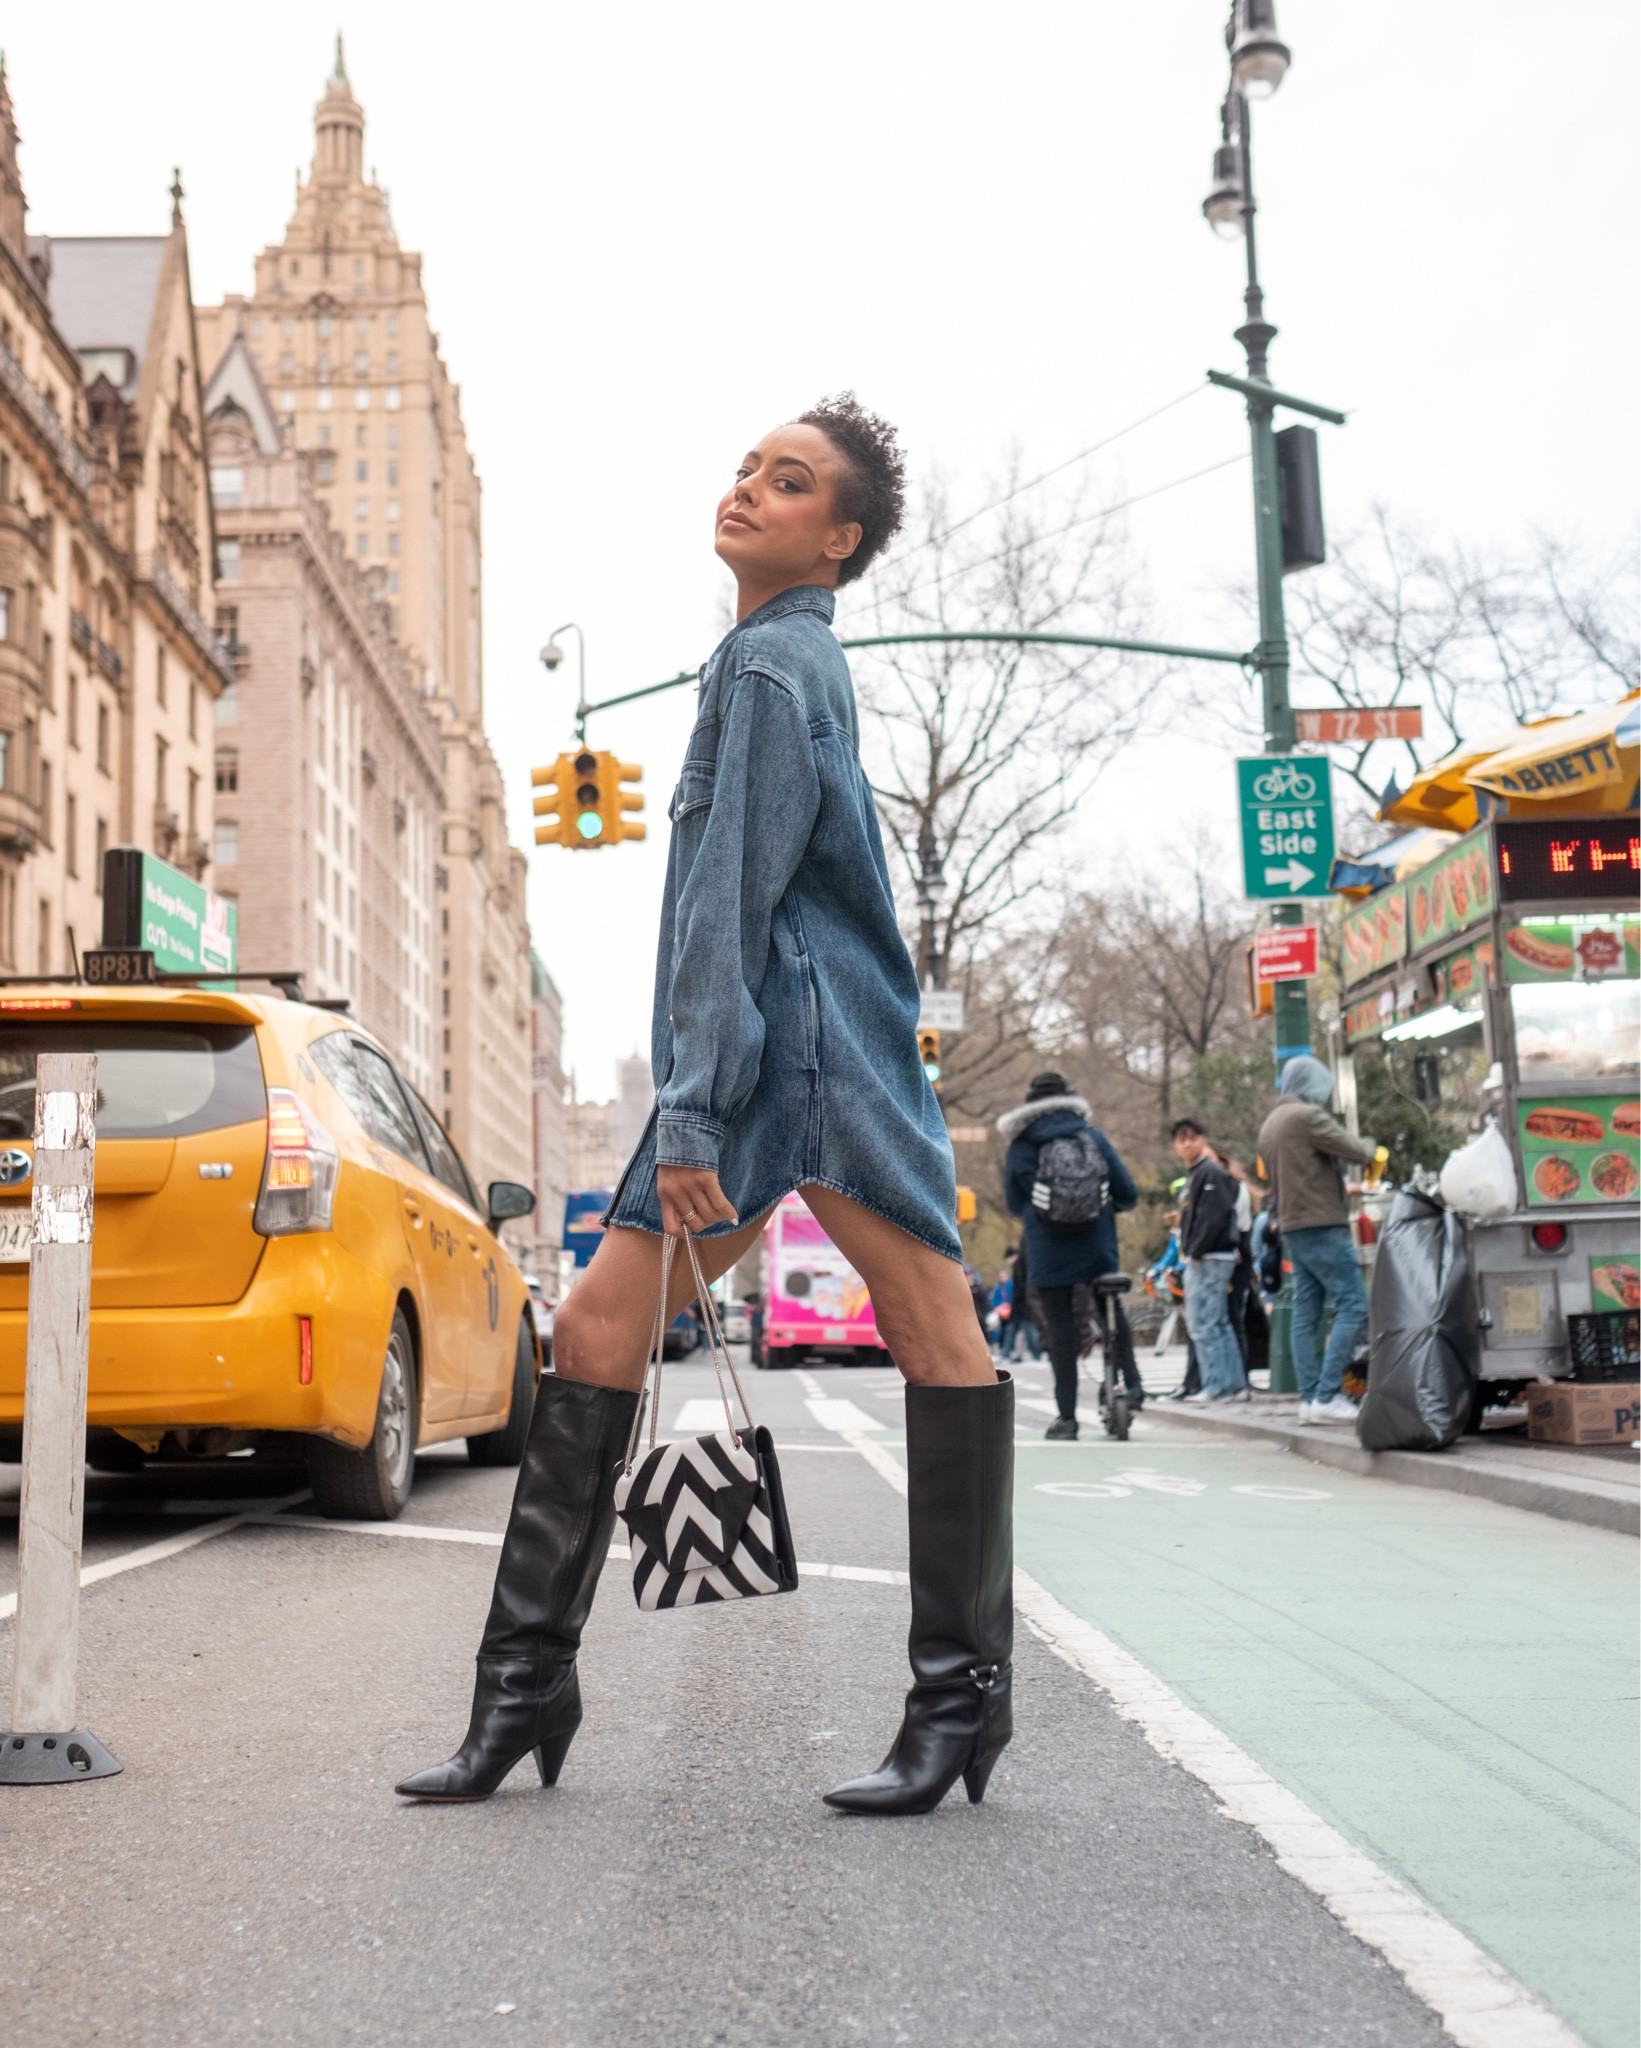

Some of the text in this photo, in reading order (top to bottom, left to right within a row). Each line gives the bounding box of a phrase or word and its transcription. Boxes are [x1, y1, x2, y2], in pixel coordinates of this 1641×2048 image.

[1301, 709, 1399, 740] W 72 ST
[1257, 807, 1317, 831] East
[1259, 832, 1317, 856] Side
[87, 954, 144, 982] 8P81
